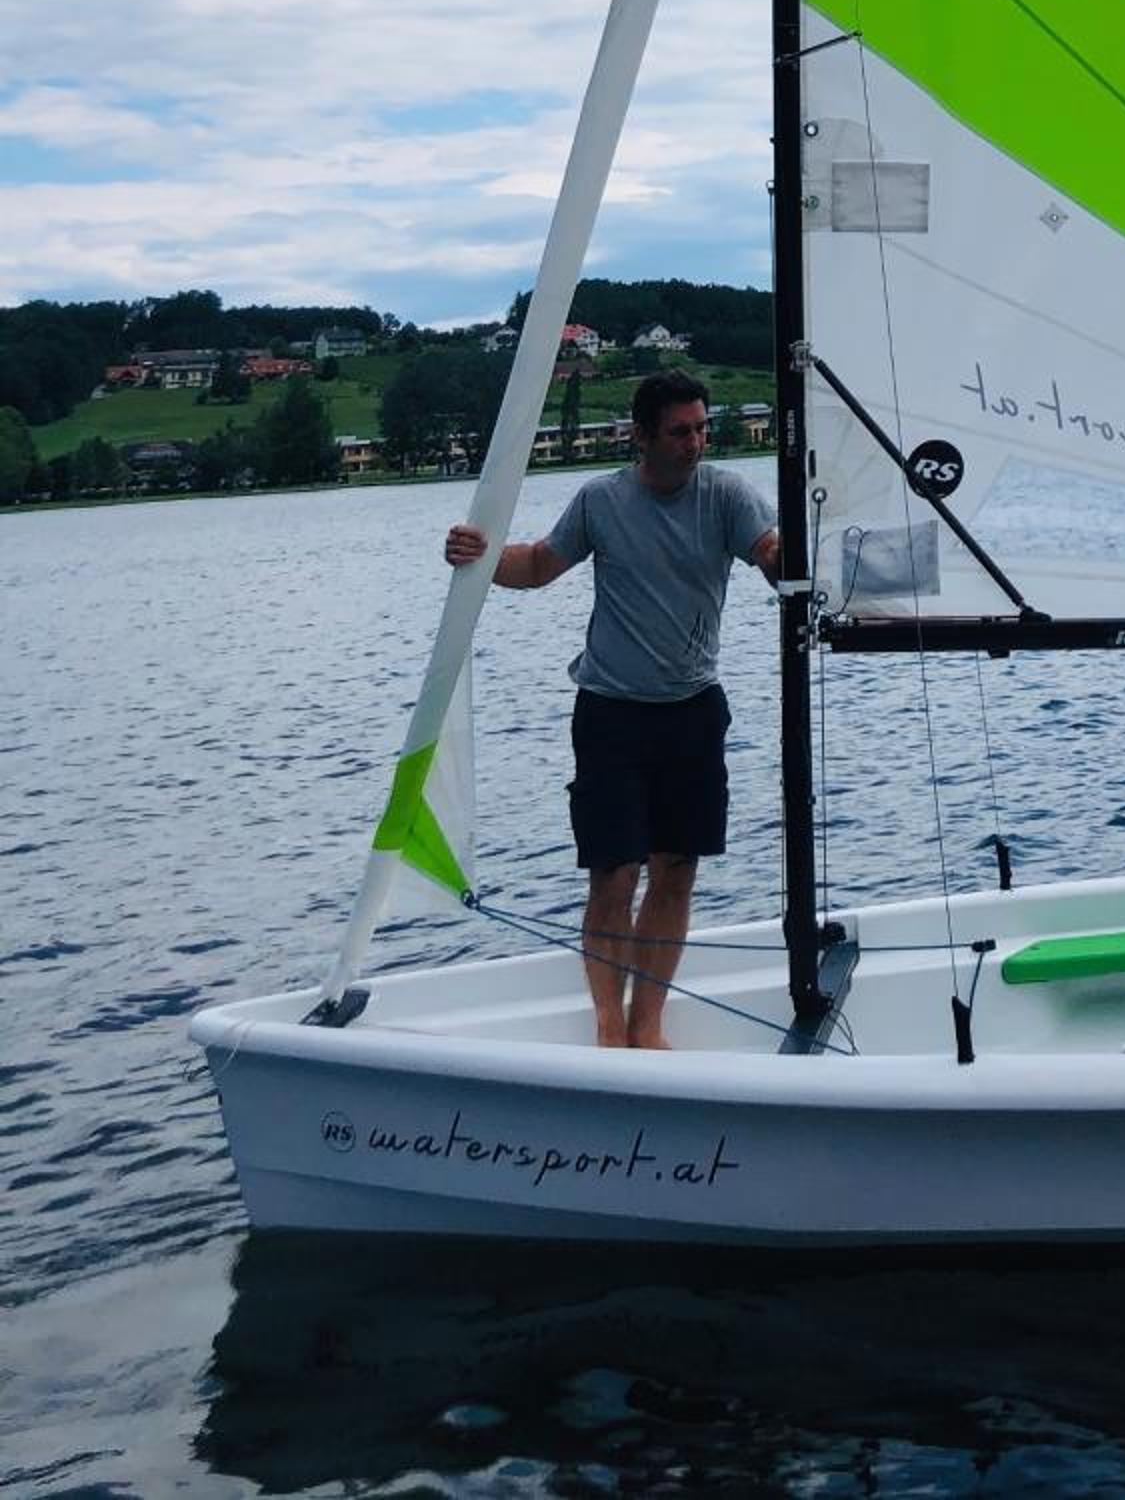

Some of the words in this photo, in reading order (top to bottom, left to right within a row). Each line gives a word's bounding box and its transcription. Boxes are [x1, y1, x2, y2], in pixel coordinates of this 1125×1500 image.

[914, 458, 959, 482] RS
[324, 1123, 353, 1142] RS
[369, 1110, 739, 1186] watersport.at
